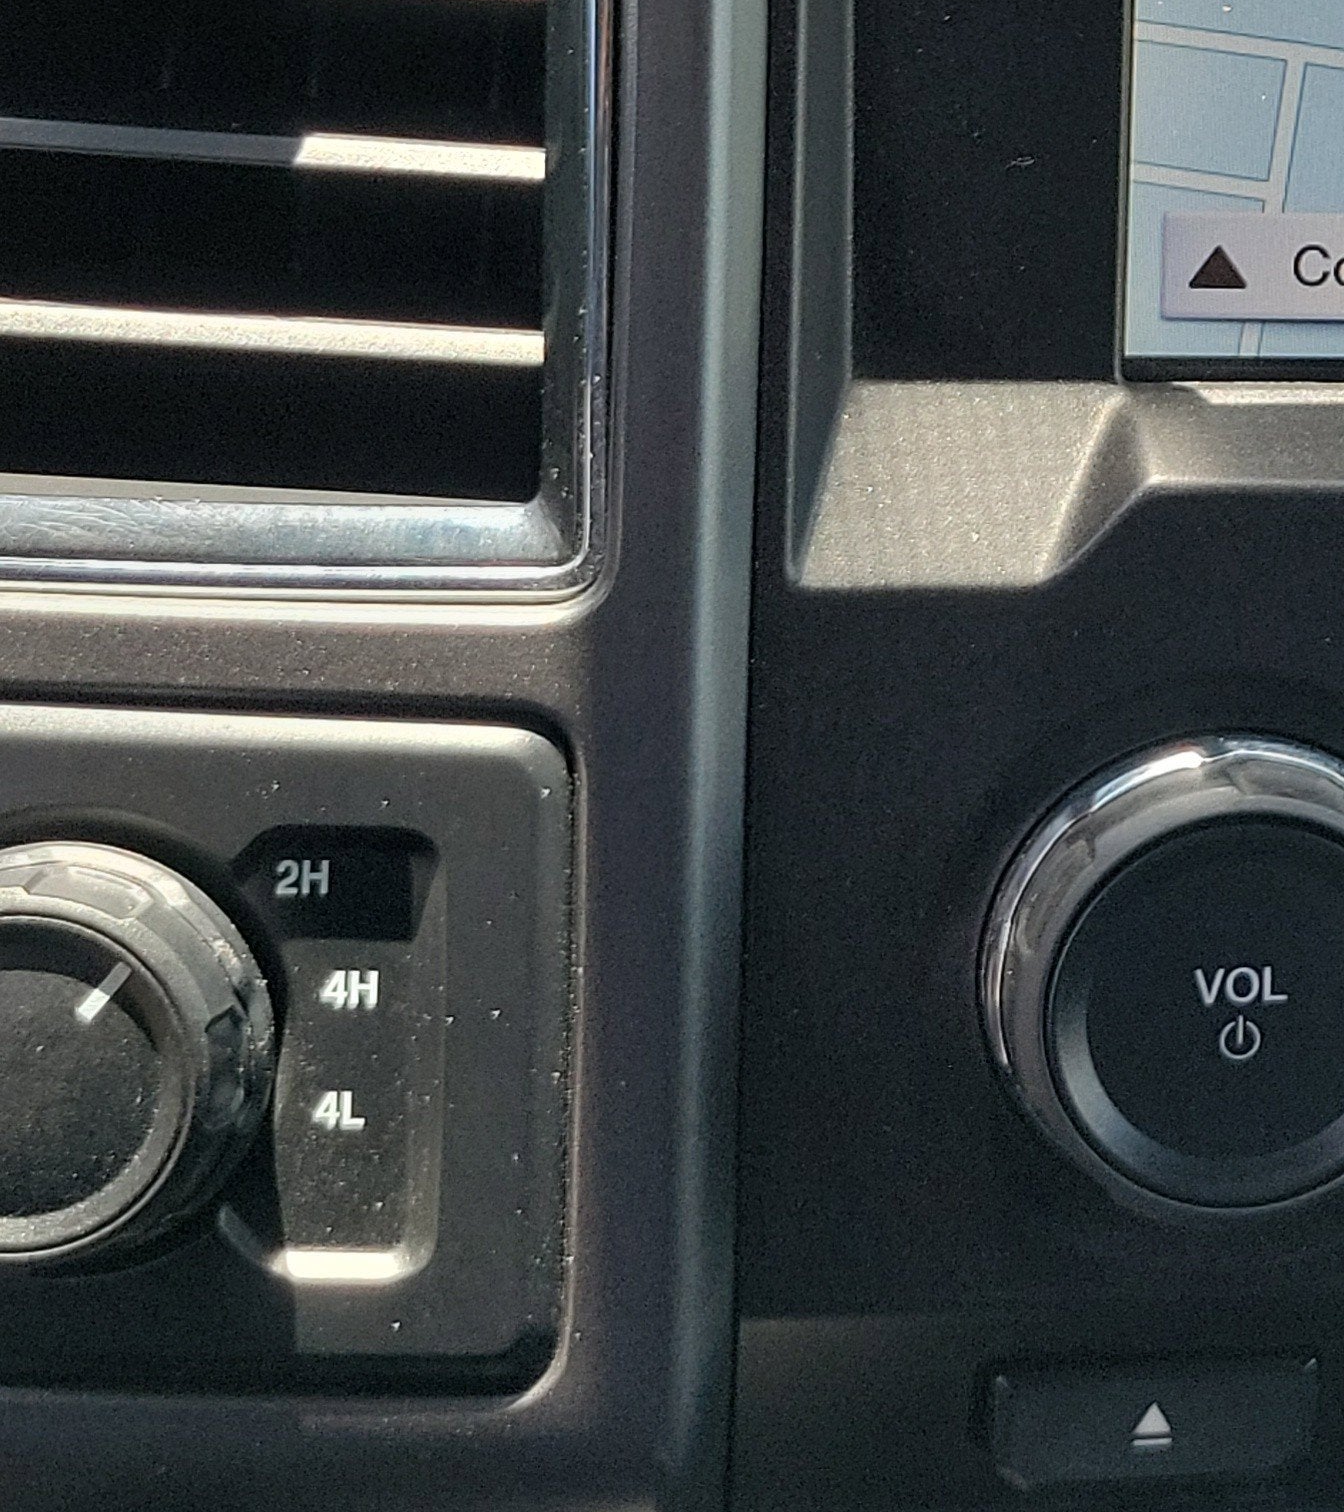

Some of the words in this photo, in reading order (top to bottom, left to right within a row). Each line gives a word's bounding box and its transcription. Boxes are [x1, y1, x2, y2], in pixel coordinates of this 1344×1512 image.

[275, 859, 331, 897] 2H
[319, 969, 379, 1010] 4H
[1194, 965, 1288, 1007] VOL
[312, 1090, 366, 1131] 4L
